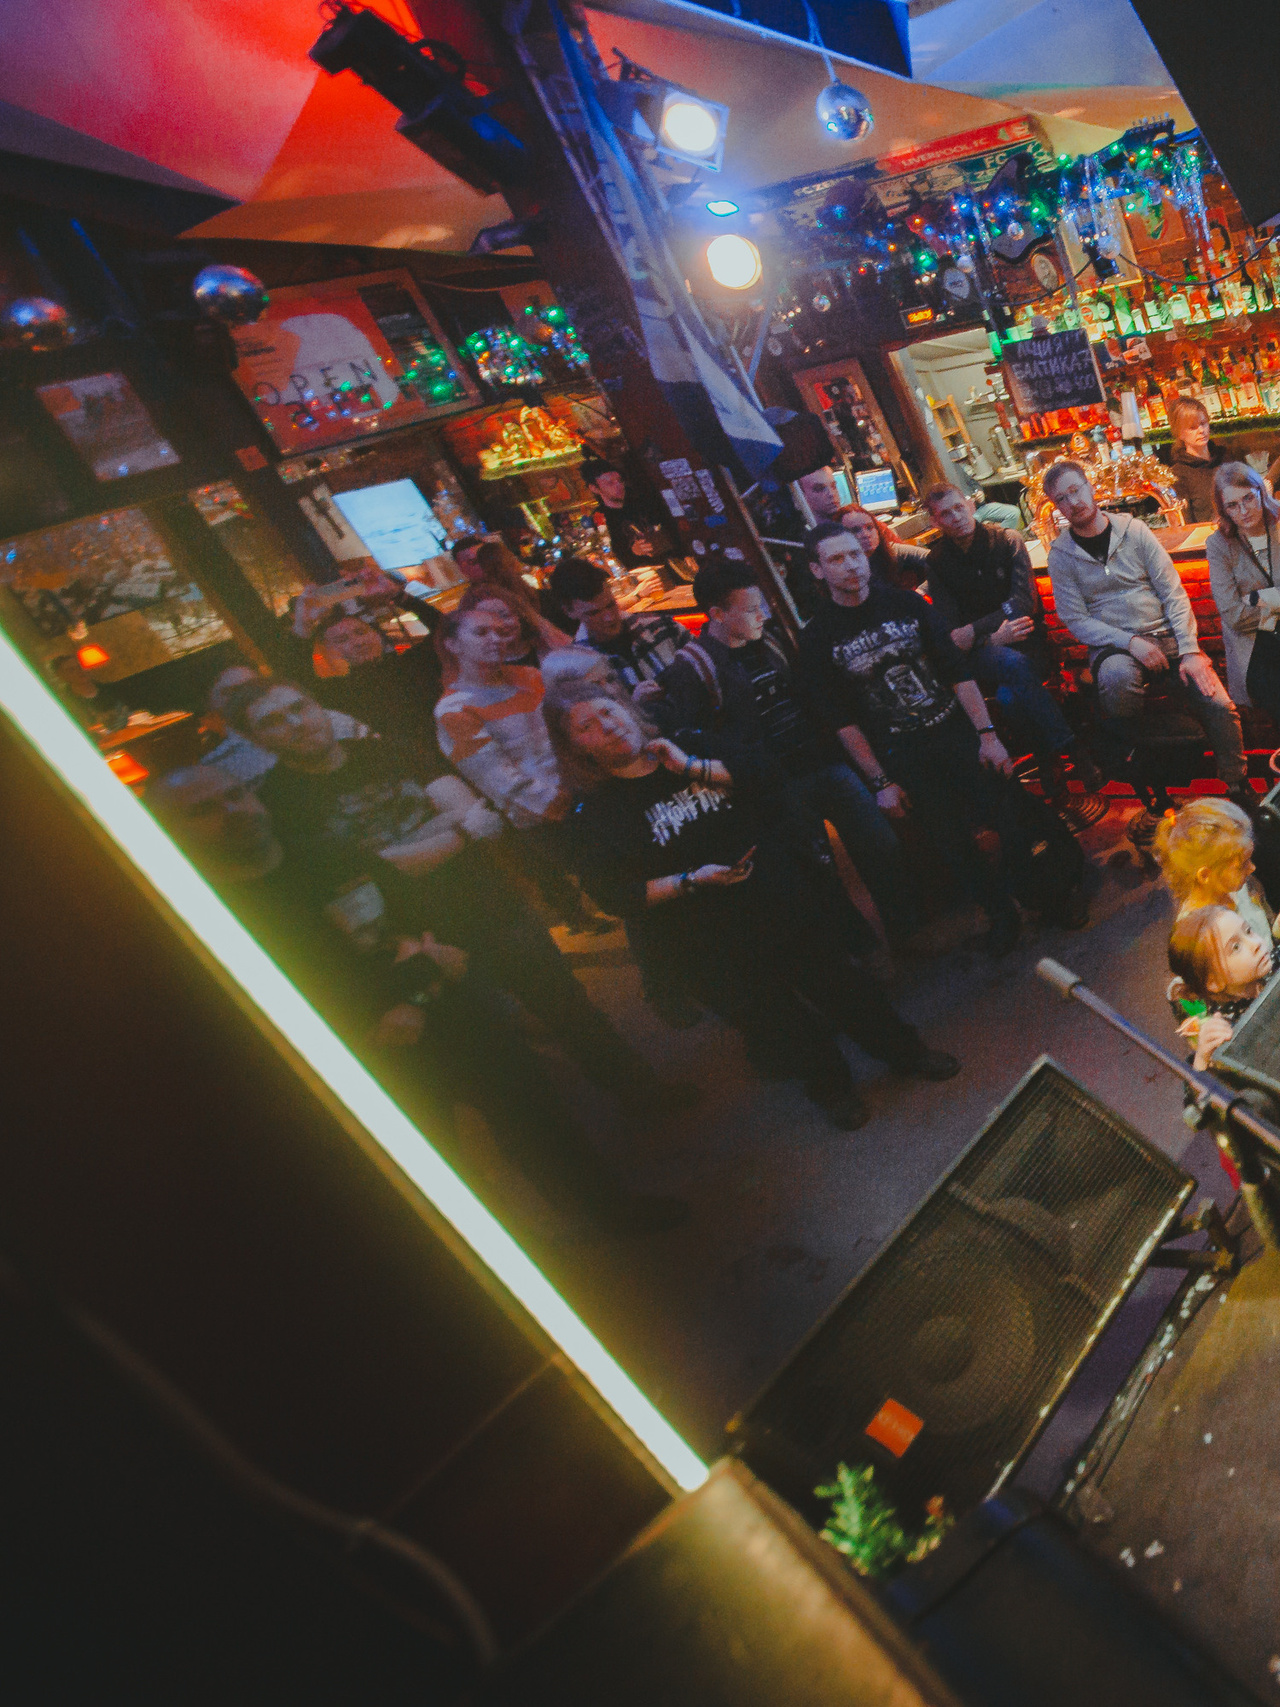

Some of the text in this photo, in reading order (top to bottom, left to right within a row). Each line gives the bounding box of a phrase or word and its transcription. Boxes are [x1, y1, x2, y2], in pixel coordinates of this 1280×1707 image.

[901, 142, 974, 167] LIVERPOOL
[984, 152, 1008, 169] FC
[254, 358, 378, 406] OPEN
